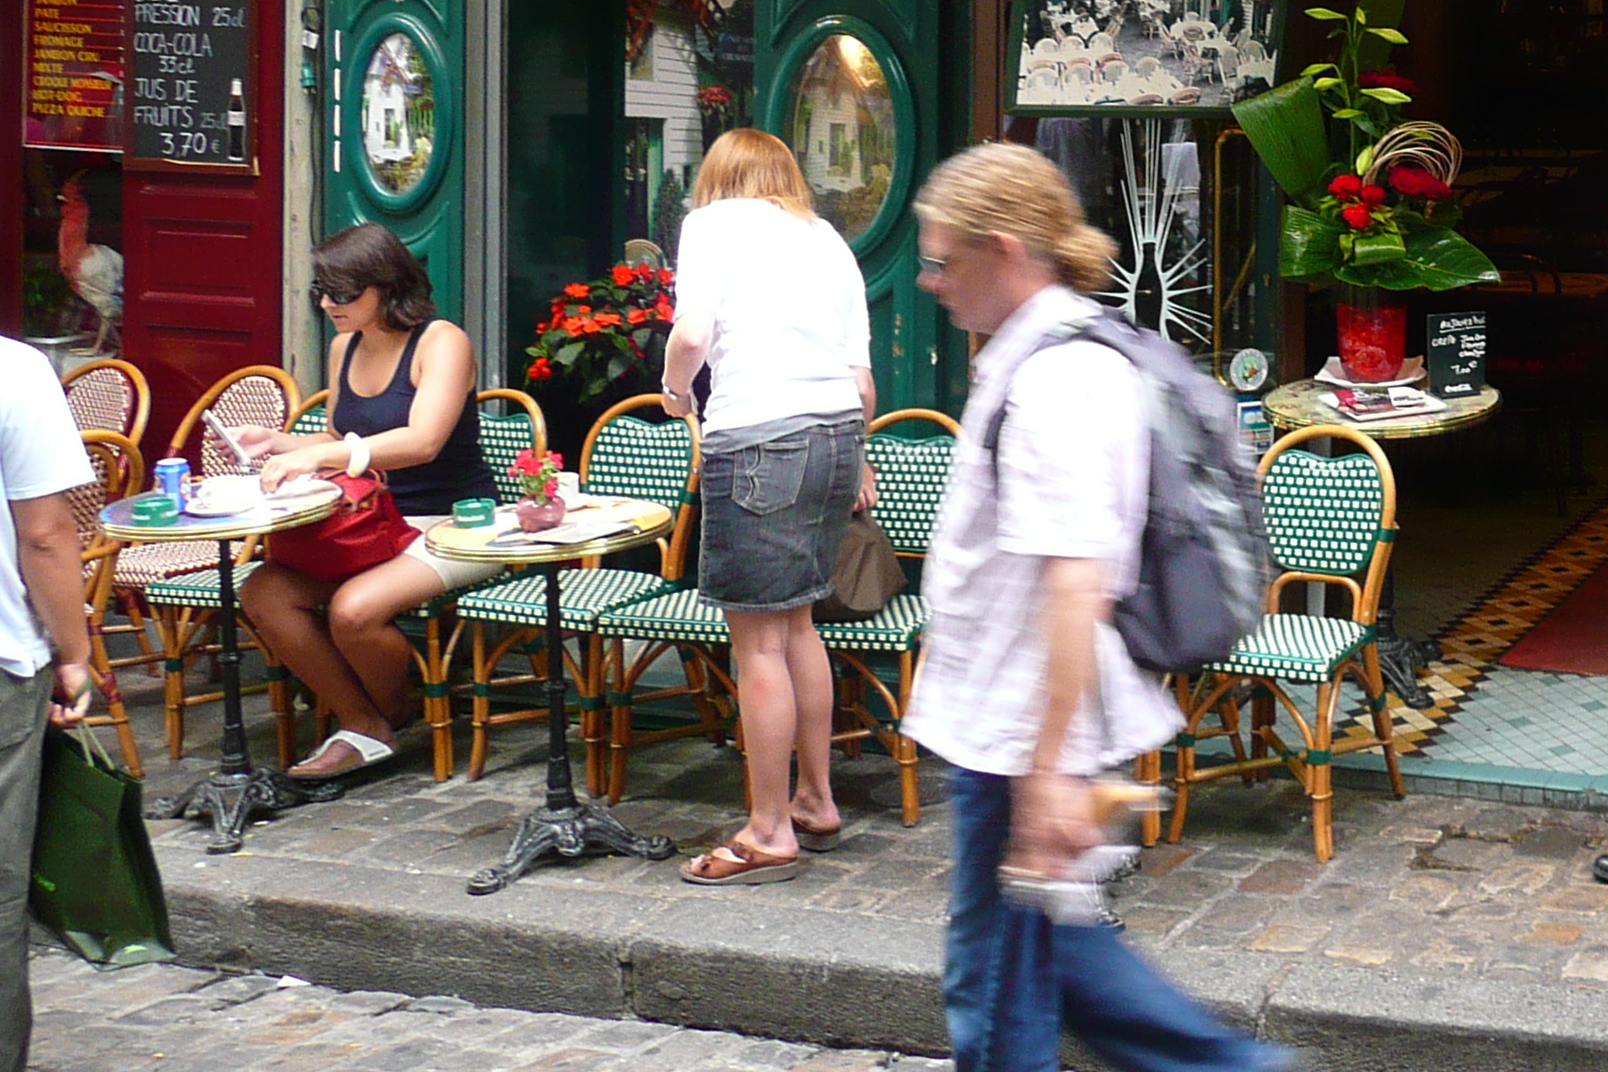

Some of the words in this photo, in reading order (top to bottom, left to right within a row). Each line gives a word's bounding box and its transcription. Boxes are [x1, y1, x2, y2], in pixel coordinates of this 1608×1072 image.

[134, 3, 201, 26] PRESSION
[133, 32, 214, 57] COCA-COLA
[134, 78, 167, 100] JUS
[175, 79, 199, 103] DE
